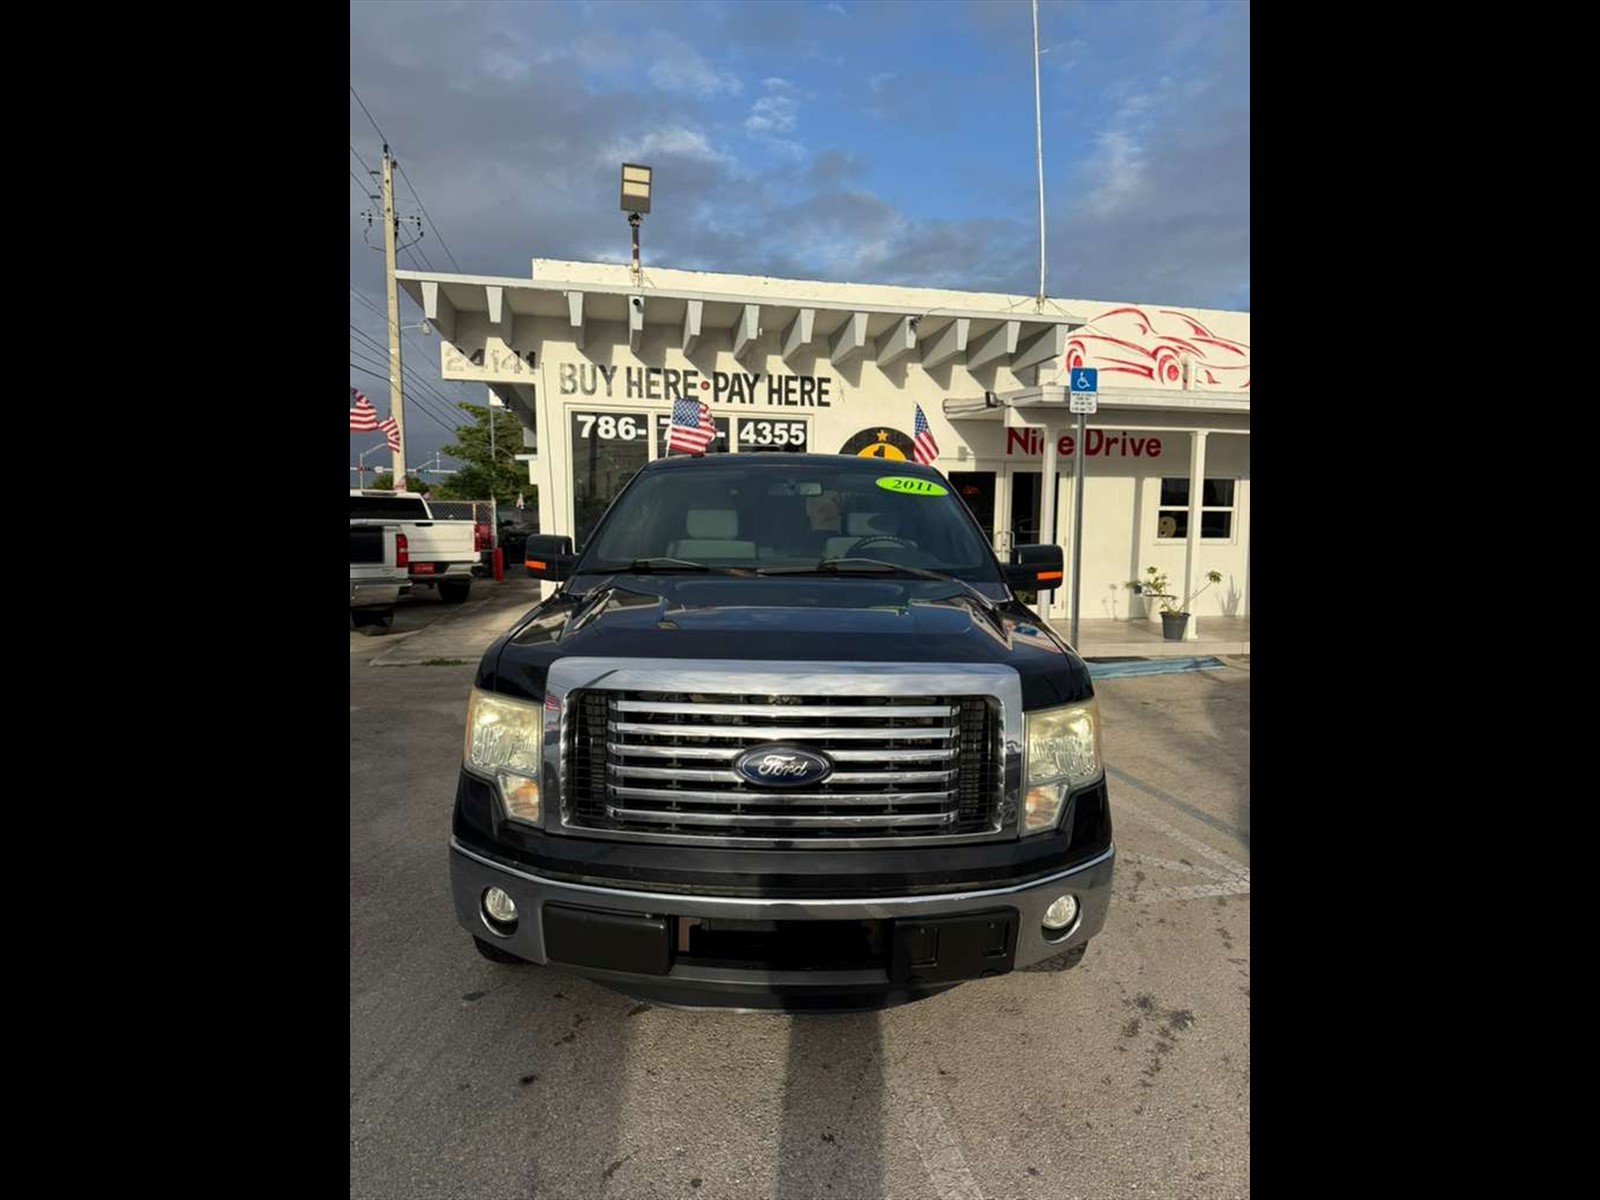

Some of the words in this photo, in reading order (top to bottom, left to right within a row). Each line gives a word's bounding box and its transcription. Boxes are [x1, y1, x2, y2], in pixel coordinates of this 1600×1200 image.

[559, 362, 617, 397] BUY
[626, 366, 699, 400] HERE
[713, 371, 761, 404] PAY
[768, 374, 831, 407] HERE
[576, 414, 647, 440] 786-
[740, 421, 805, 445] 4355
[1084, 429, 1162, 457] Drive
[893, 479, 932, 492] 2011
[758, 755, 808, 776] Ford
